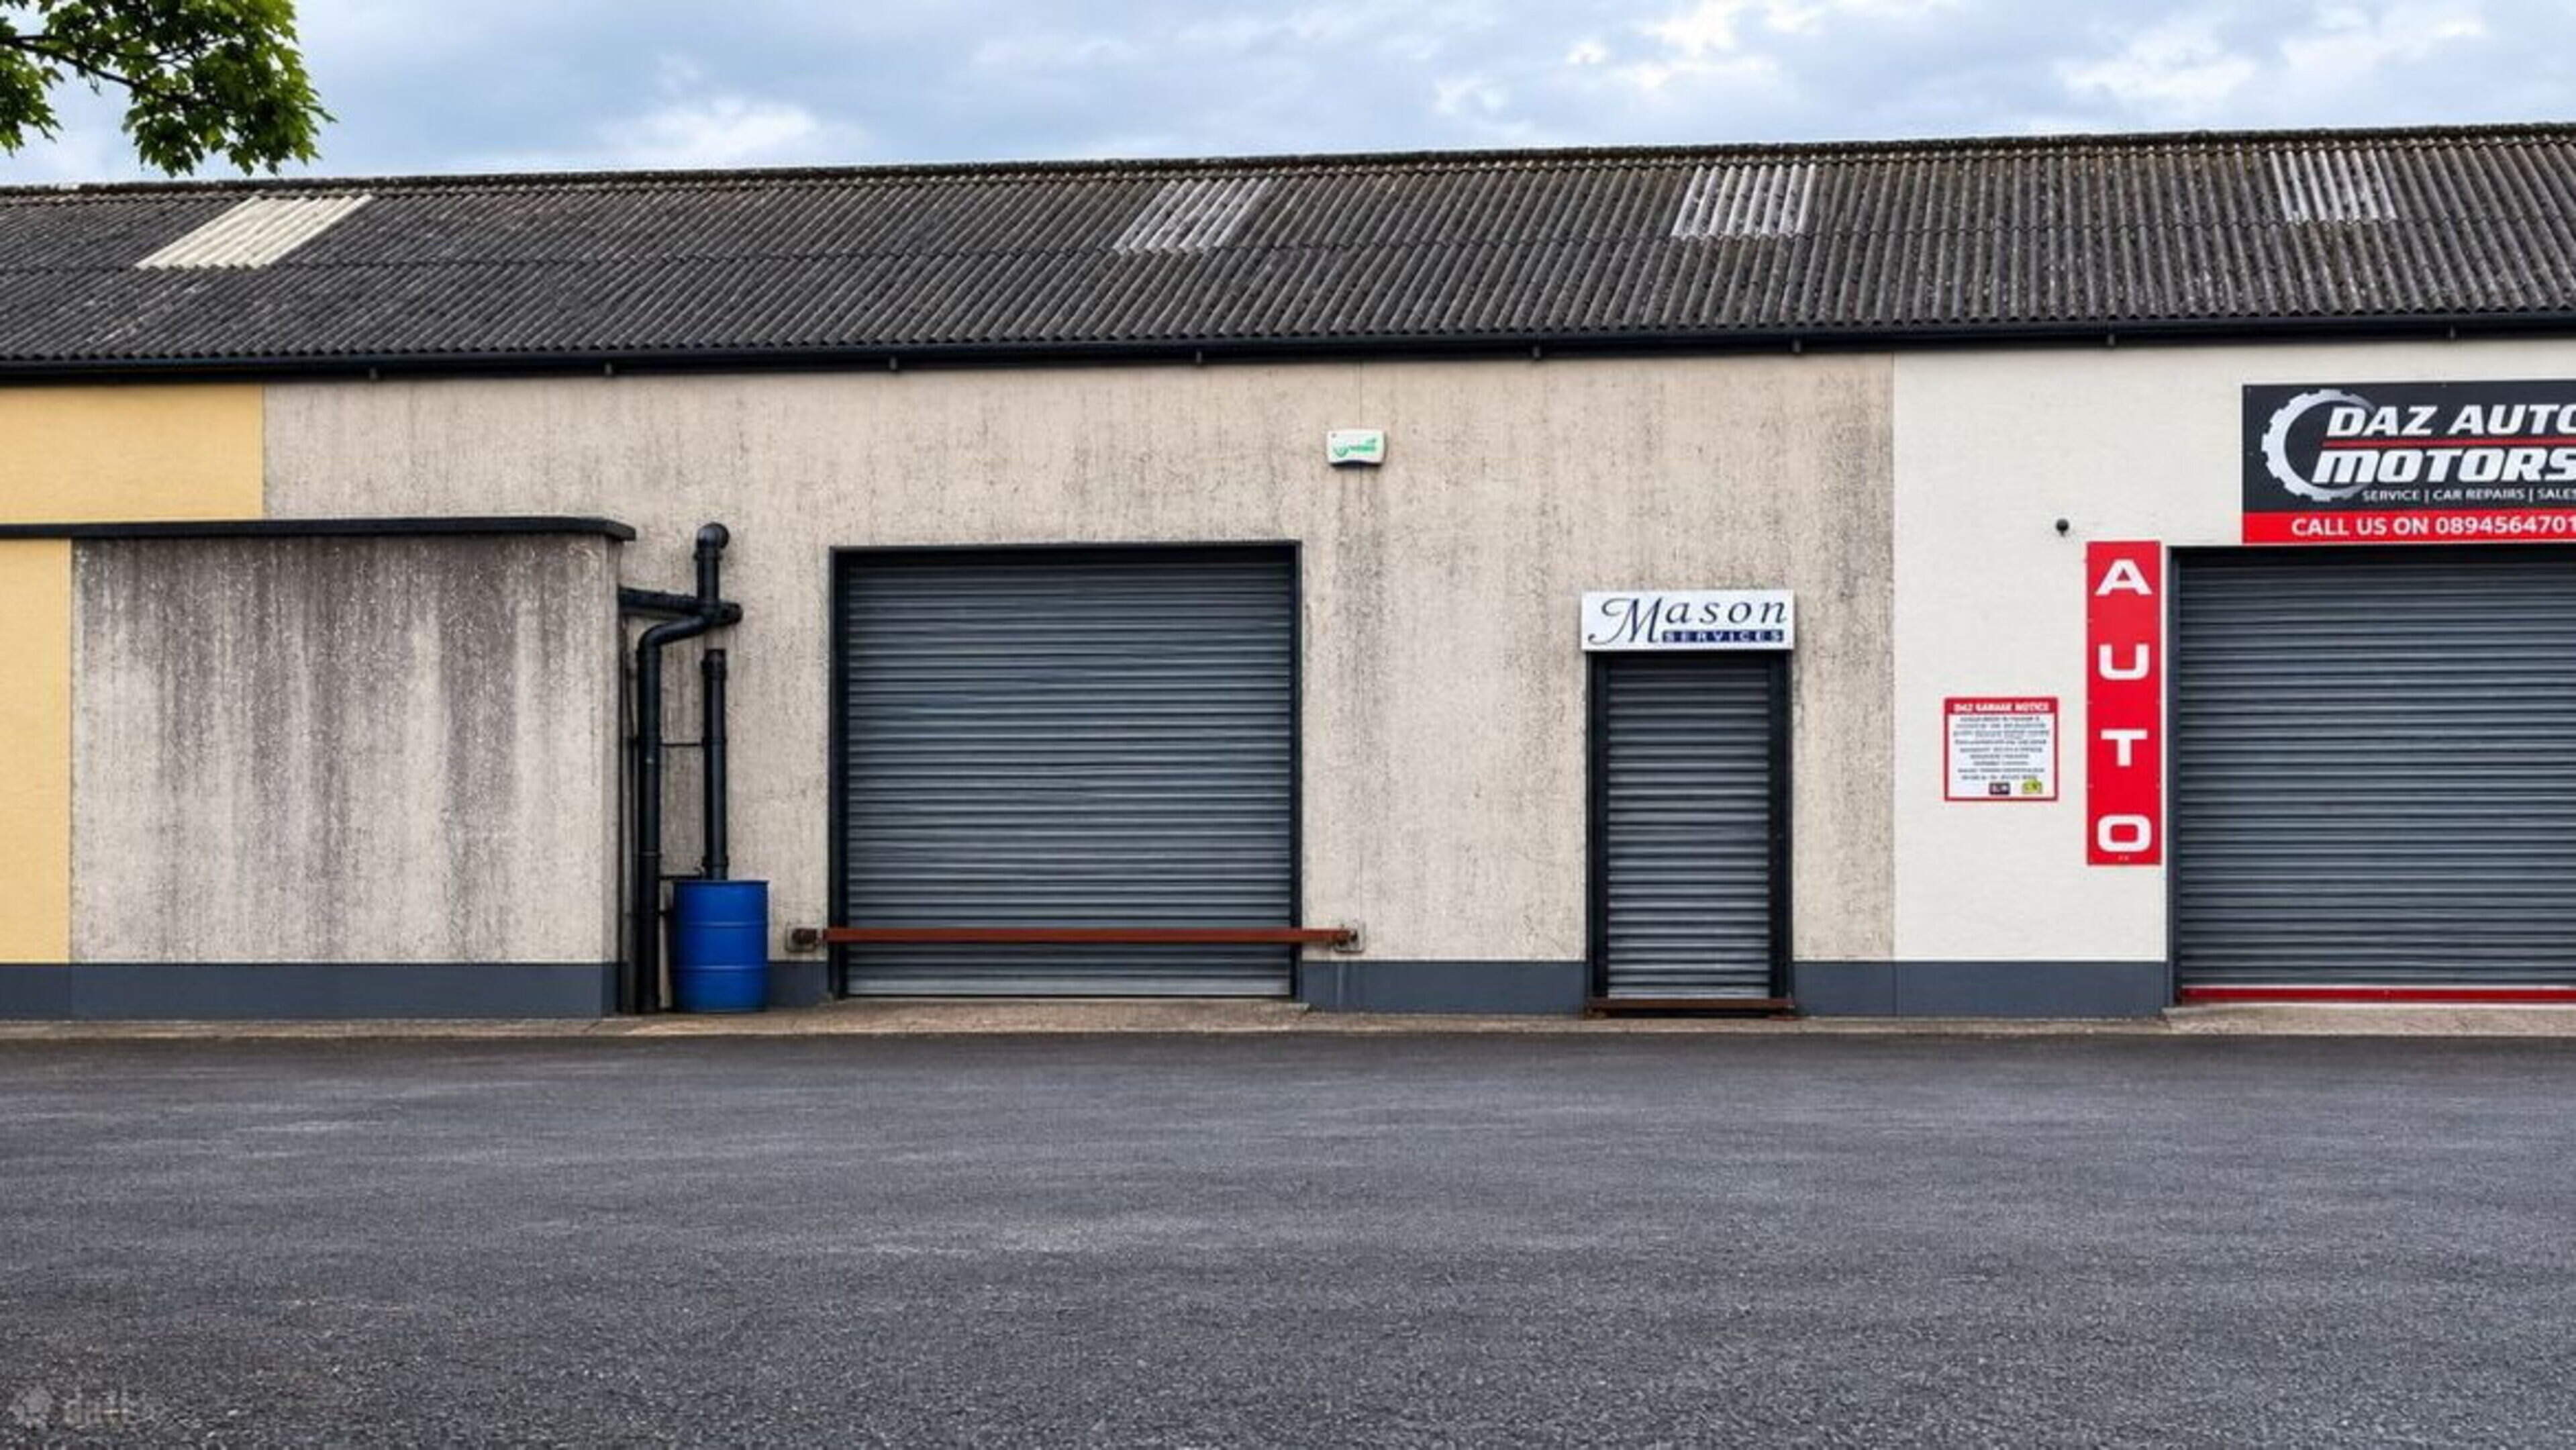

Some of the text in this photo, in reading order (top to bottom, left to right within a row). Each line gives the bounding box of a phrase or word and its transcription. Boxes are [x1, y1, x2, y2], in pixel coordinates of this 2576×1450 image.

[2326, 405, 2438, 436] DAZ
[2312, 448, 2576, 483] MOTORS
[2362, 489, 2421, 501] SERVICE
[2432, 489, 2463, 501] CAR
[2465, 487, 2525, 500] REPAIRS
[2291, 515, 2576, 536] CALL US ON 0894564701
[1588, 596, 1787, 646] Mason
[1663, 630, 1784, 643] SERVICES
[2095, 559, 2152, 853] AUTO
